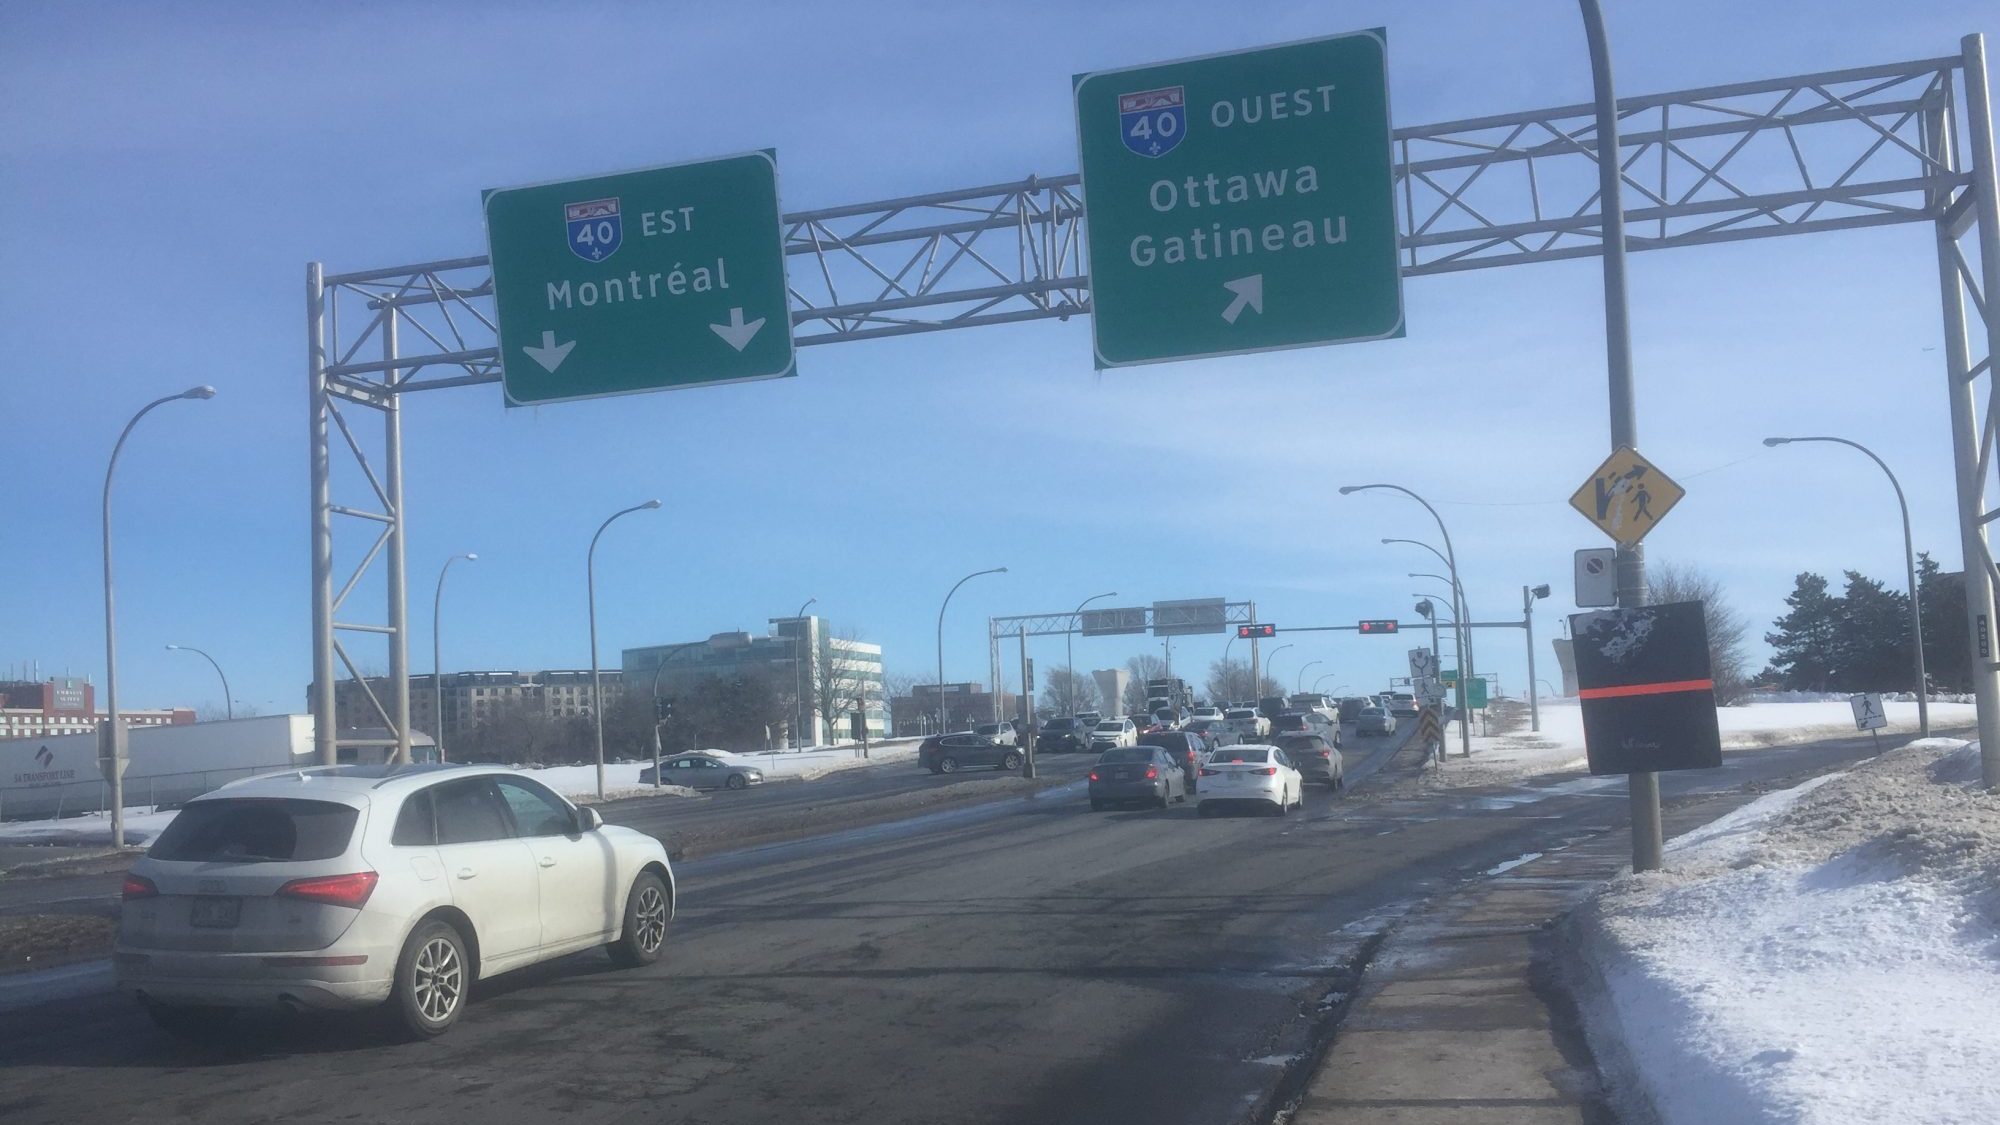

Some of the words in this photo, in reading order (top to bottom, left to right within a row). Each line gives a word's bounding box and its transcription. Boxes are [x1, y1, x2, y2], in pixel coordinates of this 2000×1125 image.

[1131, 112, 1176, 139] 40
[1211, 84, 1336, 128] OUEST
[1150, 165, 1318, 212] Ottawa
[577, 221, 613, 245] 40
[641, 207, 694, 236] EST
[1130, 216, 1347, 267] Gatineau
[547, 257, 729, 310] Montréal
[23, 770, 59, 782] TRANSPORT
[60, 769, 75, 779] LINE
